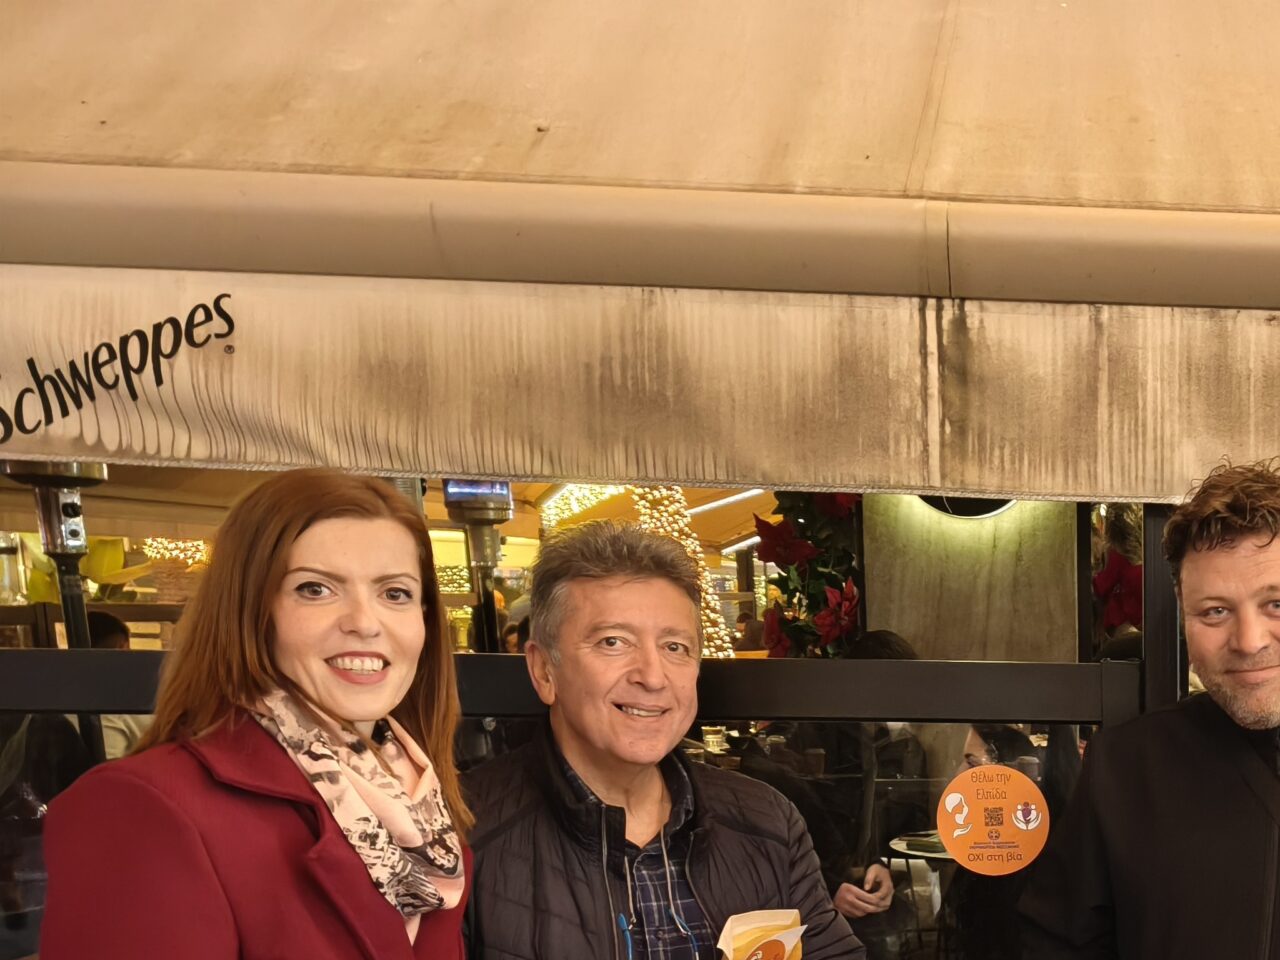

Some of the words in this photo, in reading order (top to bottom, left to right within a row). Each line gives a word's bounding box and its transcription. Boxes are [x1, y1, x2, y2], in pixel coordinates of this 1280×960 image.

[970, 771, 994, 783] Θέλω
[996, 773, 1011, 785] την
[976, 788, 1007, 800] Ελπίδα
[987, 854, 1004, 863] στη
[1006, 852, 1023, 862] βία
